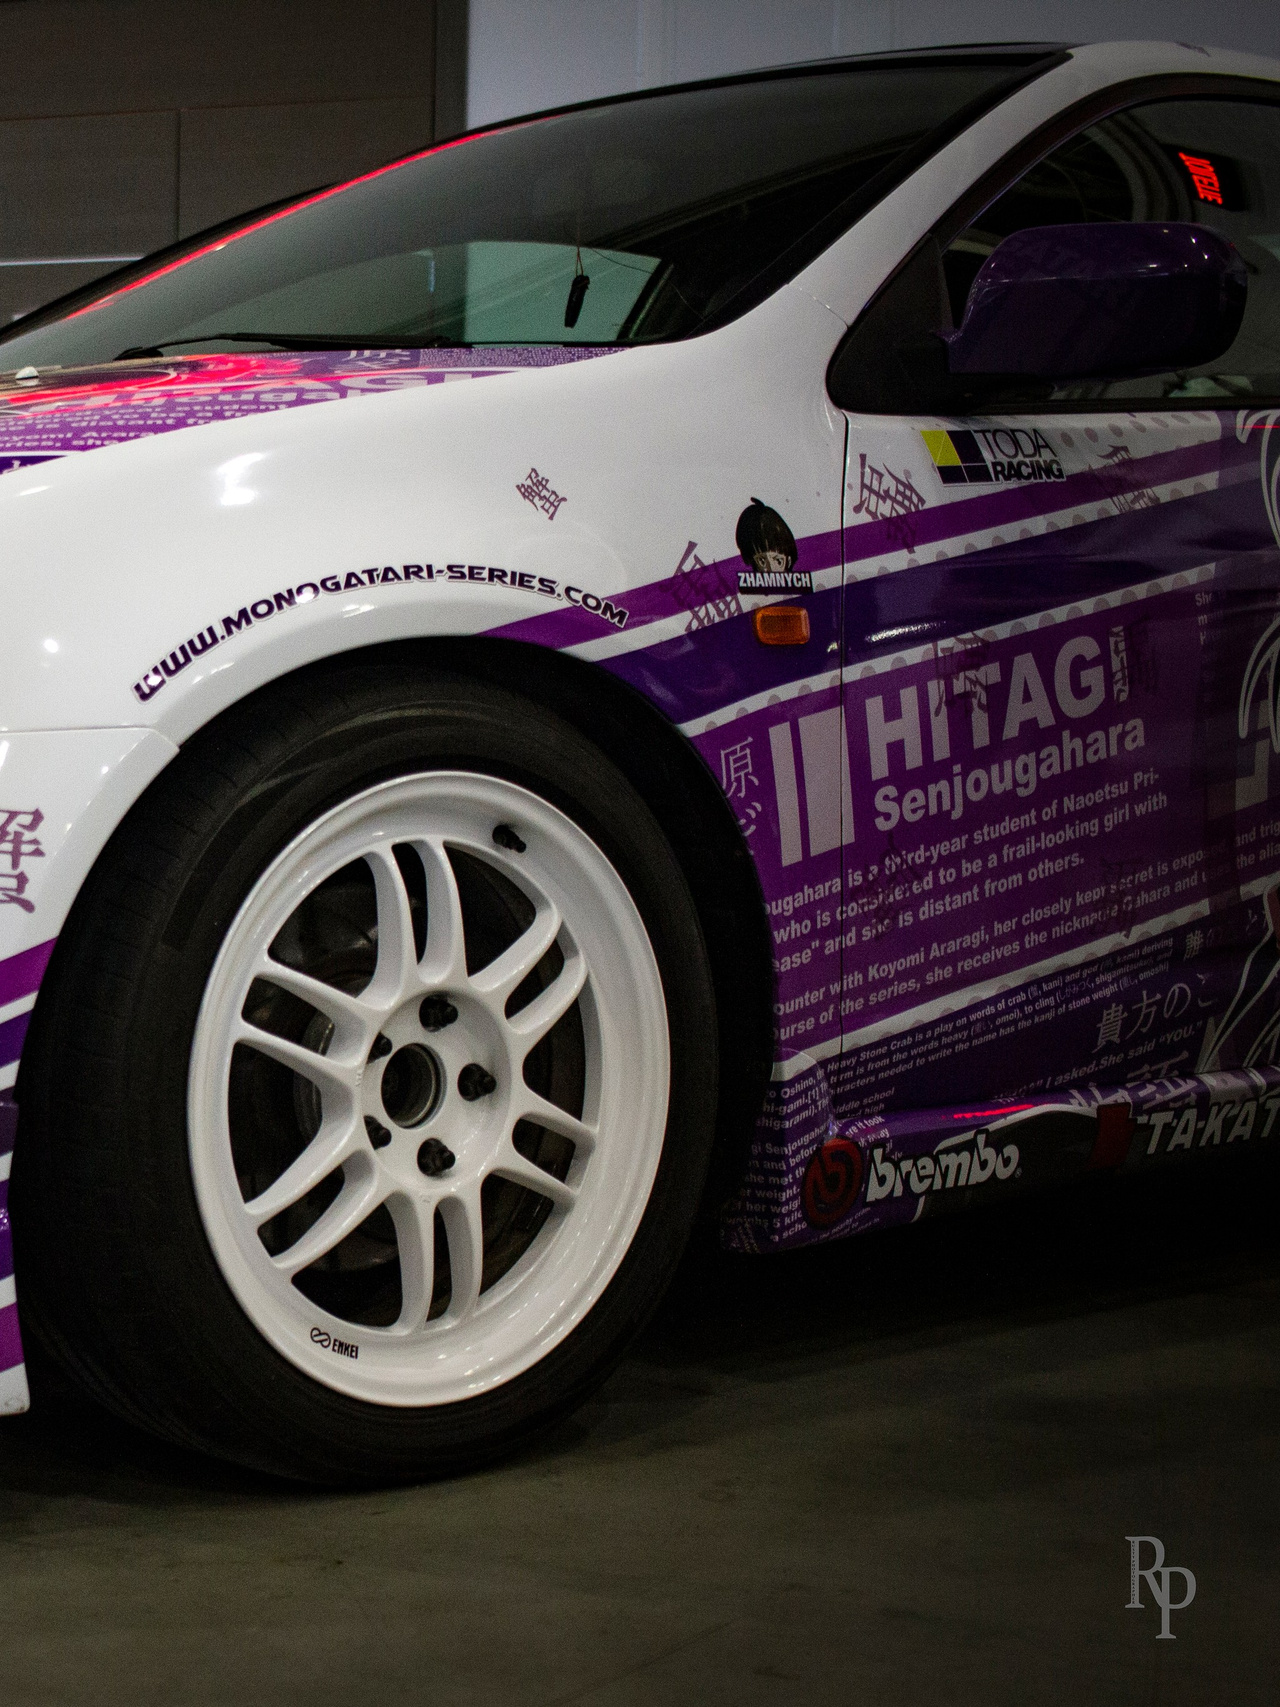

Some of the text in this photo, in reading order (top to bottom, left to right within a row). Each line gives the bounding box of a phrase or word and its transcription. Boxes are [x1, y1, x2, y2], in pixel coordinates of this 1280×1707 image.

[973, 428, 1058, 460] TODA
[991, 459, 1066, 482] RACING
[737, 571, 812, 588] ZHAMNYCH
[873, 717, 1146, 832] Senjougahara
[773, 919, 812, 945] who
[816, 910, 832, 930] is
[938, 867, 957, 886] to
[961, 857, 983, 877] be
[987, 853, 998, 869] a
[1002, 818, 1100, 864] frail-looking
[1103, 803, 1130, 833] girl
[1134, 791, 1168, 818] with
[847, 868, 863, 889] is
[884, 834, 969, 876] third-year
[973, 808, 1038, 846] student
[1041, 799, 1058, 822] of
[1062, 779, 1129, 815] Naoetsu
[1133, 767, 1160, 792] Pri-
[820, 1004, 835, 1025] of
[840, 996, 865, 1016] the
[868, 978, 921, 1007] series,
[926, 965, 954, 986] she
[957, 941, 1021, 975] receives
[1024, 930, 1048, 950] the
[1174, 870, 1198, 893] and
[824, 926, 857, 955] and
[898, 911, 914, 929] is
[918, 883, 981, 921] distant
[984, 872, 1023, 899] from
[1027, 852, 1085, 883] others.
[829, 971, 864, 998] with
[868, 947, 926, 983] Koyomi
[928, 925, 990, 961] Araragi,
[993, 916, 1019, 939] her
[1021, 897, 1073, 926] closely
[1157, 861, 1170, 877] is
[827, 1055, 858, 1074] Heavy
[860, 1046, 888, 1062] Stone
[890, 1035, 913, 1051] Crab
[915, 1032, 923, 1042] is
[934, 1021, 954, 1036] play
[956, 1016, 967, 1028] on
[969, 1005, 996, 1023] words
[997, 998, 1006, 1011] of
[1008, 991, 1027, 1007] crab
[1065, 969, 1081, 983] and
[856, 1065, 865, 1076] is
[867, 1057, 890, 1072] from
[892, 1051, 908, 1063] the
[910, 1040, 939, 1056] words
[941, 1029, 969, 1046] heavy
[1024, 1004, 1034, 1015] to
[1035, 996, 1055, 1011] cling
[878, 1060, 914, 1080] needed
[916, 1056, 926, 1067] to
[928, 1047, 953, 1063] write
[955, 1041, 970, 1053] the
[972, 1031, 998, 1047] name
[1000, 1026, 1016, 1038] has
[1018, 1019, 1033, 1031] the
[1034, 1009, 1056, 1024] kanji
[1057, 1003, 1066, 1014] of
[1068, 995, 1091, 1011] stone
[1092, 981, 1119, 1001] weight
[1128, 1038, 1157, 1060] said
[862, 1086, 895, 1106] school
[865, 1132, 1021, 1203] brembo
[331, 1338, 359, 1360] ENKEI
